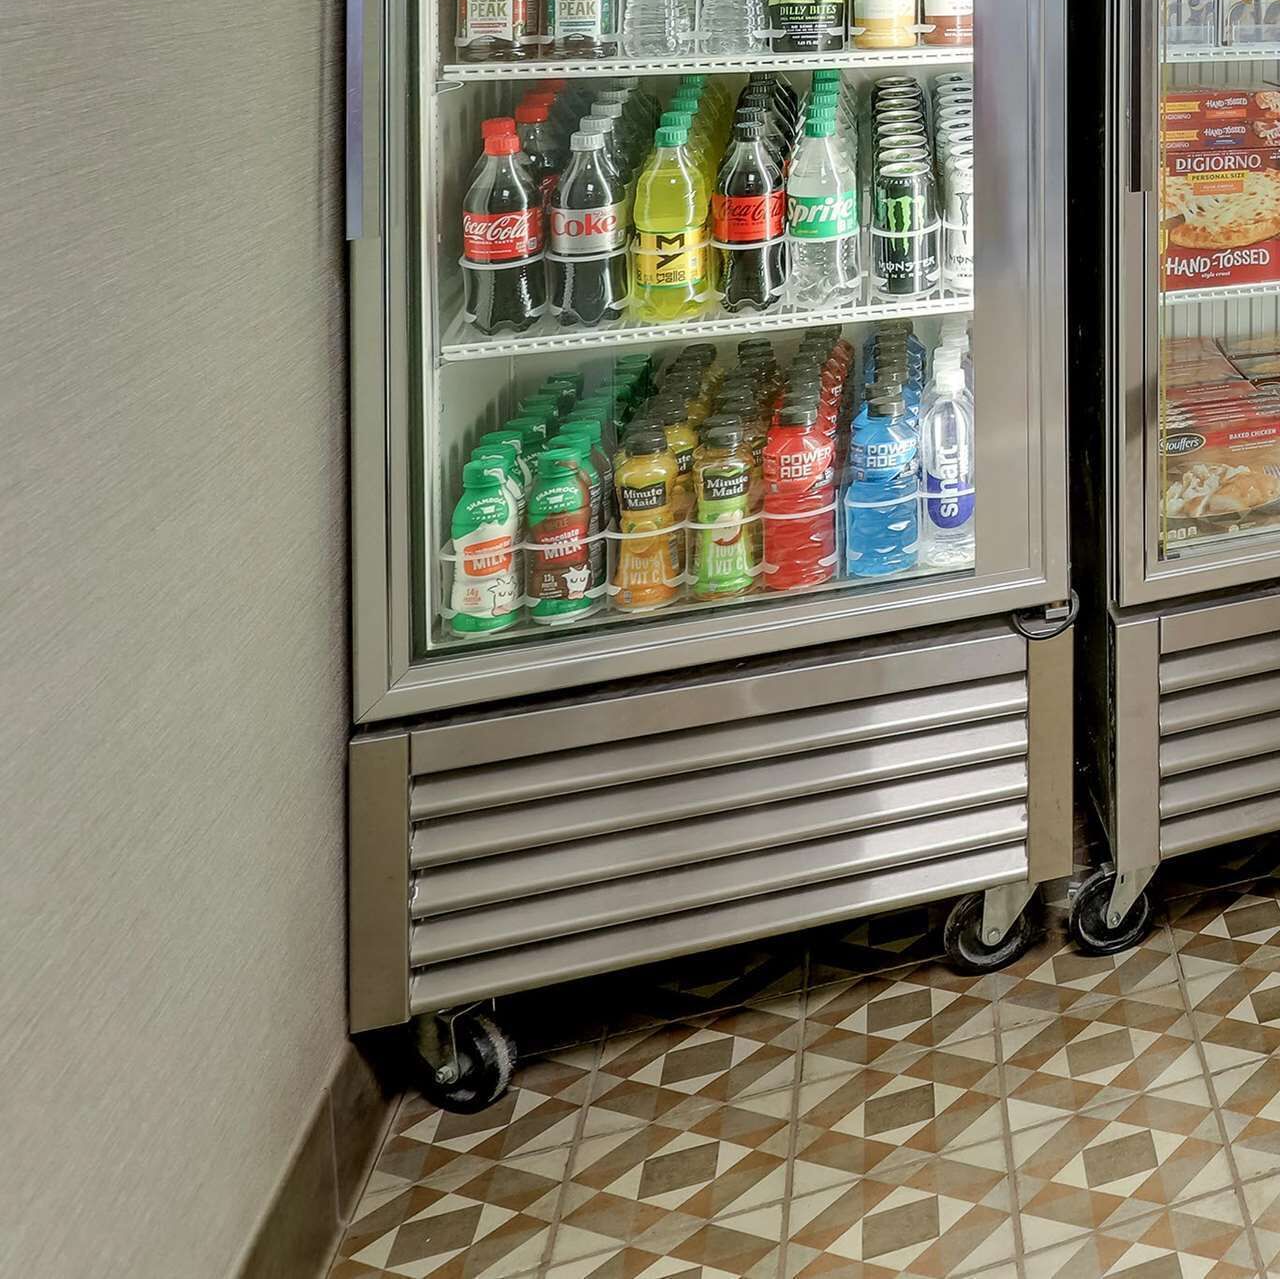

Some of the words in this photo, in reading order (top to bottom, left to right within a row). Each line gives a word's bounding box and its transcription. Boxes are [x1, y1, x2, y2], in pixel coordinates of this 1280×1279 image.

[470, 2, 509, 17] PEAK
[559, 1, 596, 17] PEAK
[780, 6, 806, 16] DILLY
[1191, 173, 1229, 181] PERSONAL
[787, 198, 854, 227] Sprite
[552, 213, 617, 238] Coke
[879, 256, 935, 271] MONSTER
[1167, 249, 1270, 276] HAND-TOSSED
[1229, 431, 1250, 440] BAKED
[1251, 429, 1277, 437] CHICKEN
[781, 447, 831, 465] POWER
[867, 440, 917, 457] POWER
[866, 455, 898, 468] ADE
[781, 463, 813, 478] ADE
[707, 475, 749, 489] Minute
[623, 488, 663, 499] Minute
[712, 484, 744, 498] Maid
[628, 495, 658, 507] Maid
